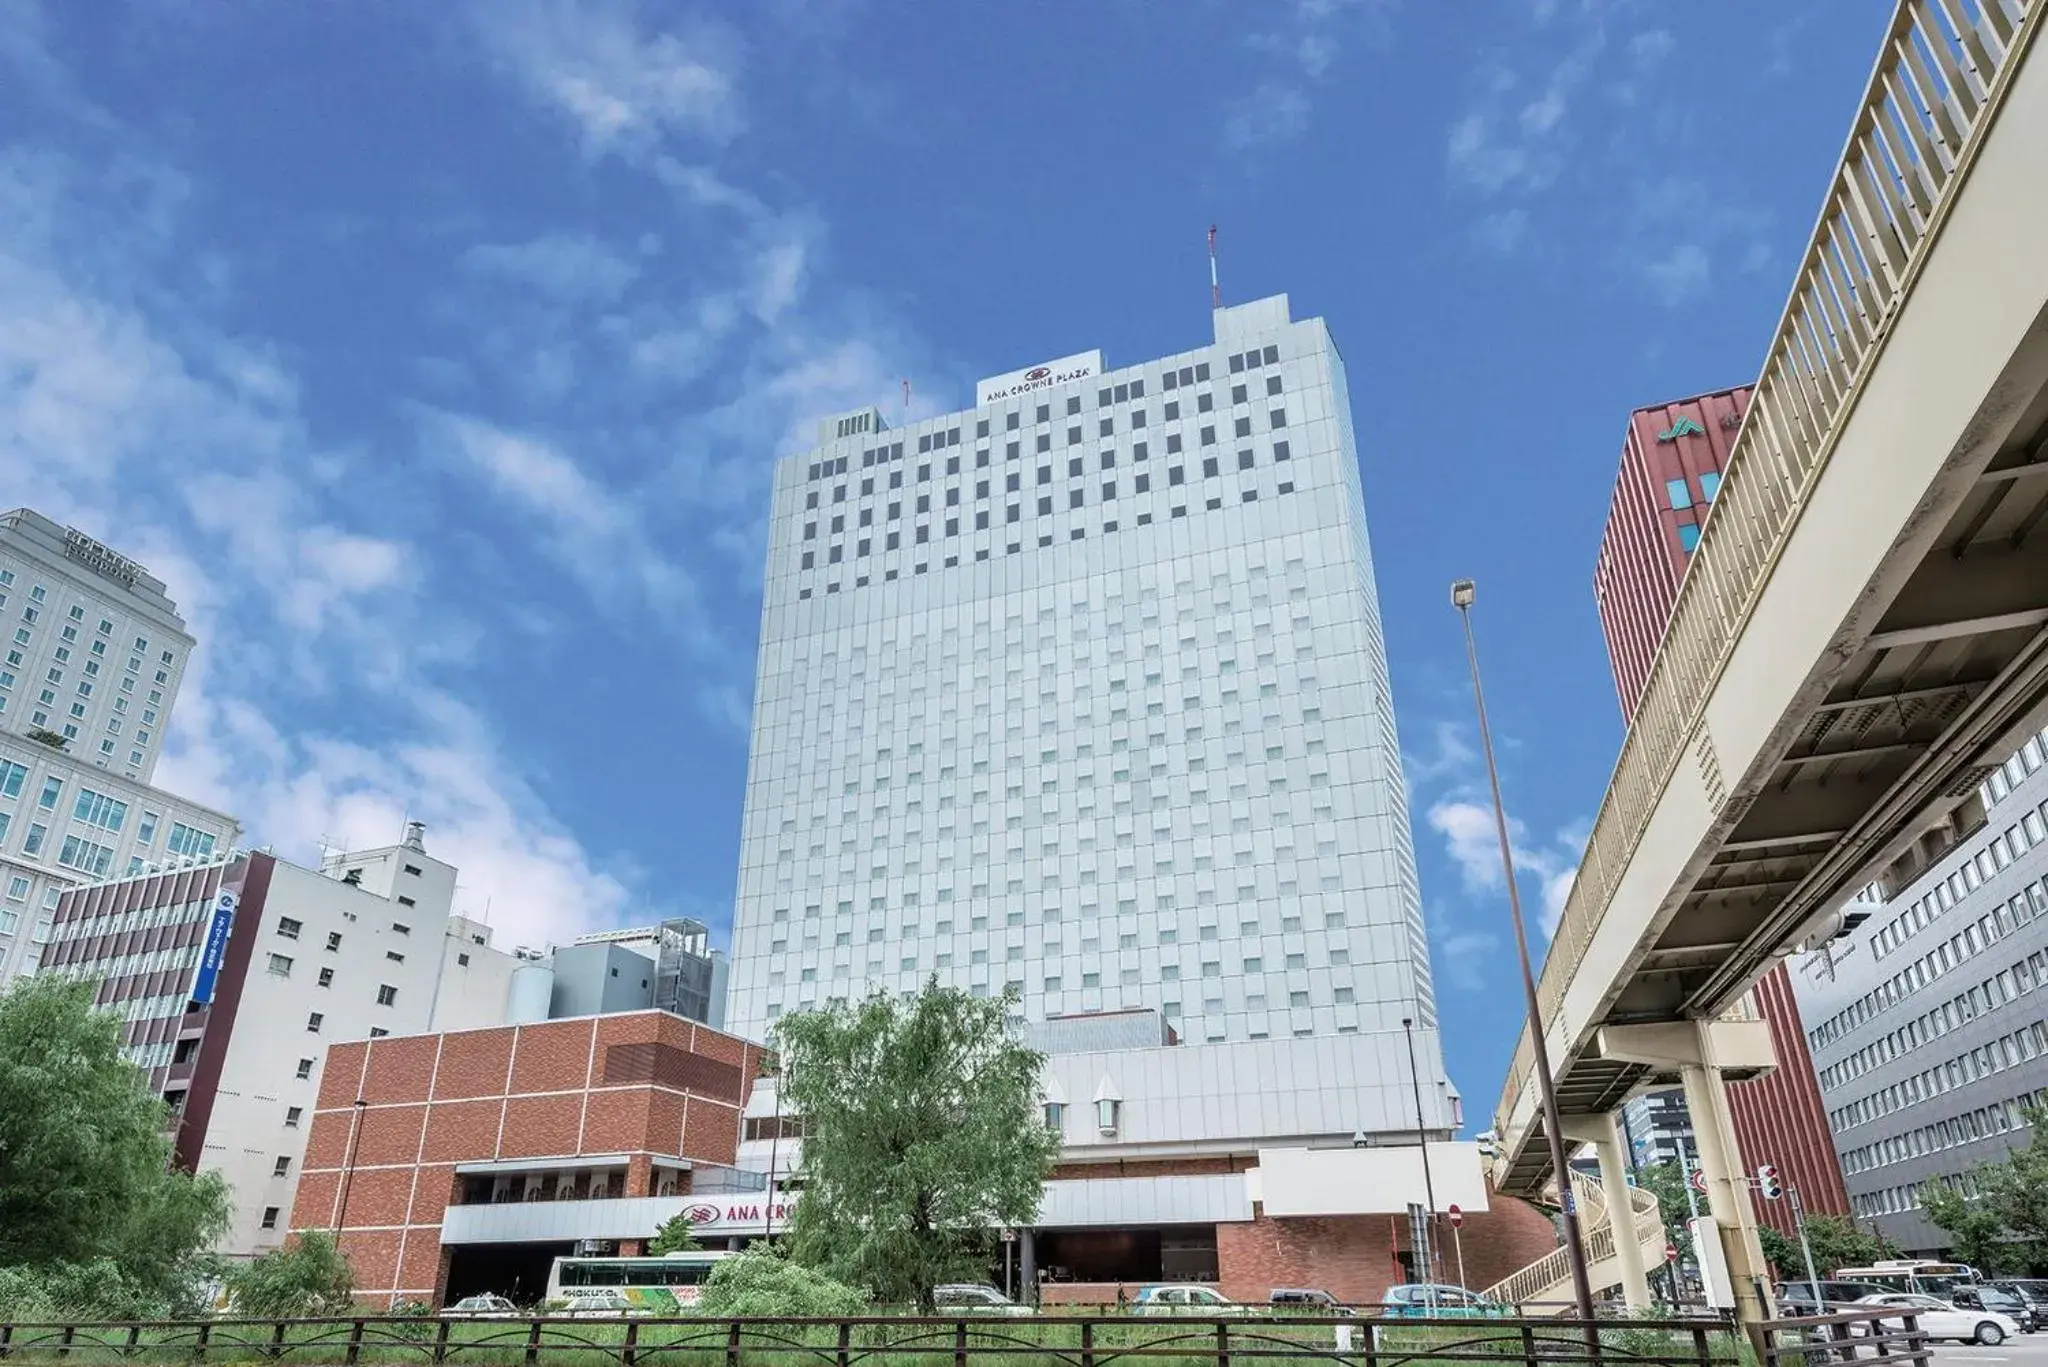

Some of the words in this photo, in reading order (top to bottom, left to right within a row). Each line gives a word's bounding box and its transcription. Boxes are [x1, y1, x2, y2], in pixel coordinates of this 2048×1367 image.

[987, 391, 1008, 402] ANA
[1010, 377, 1053, 396] CROWNE
[1056, 368, 1088, 383] PLAZA
[727, 1206, 759, 1220] ANA
